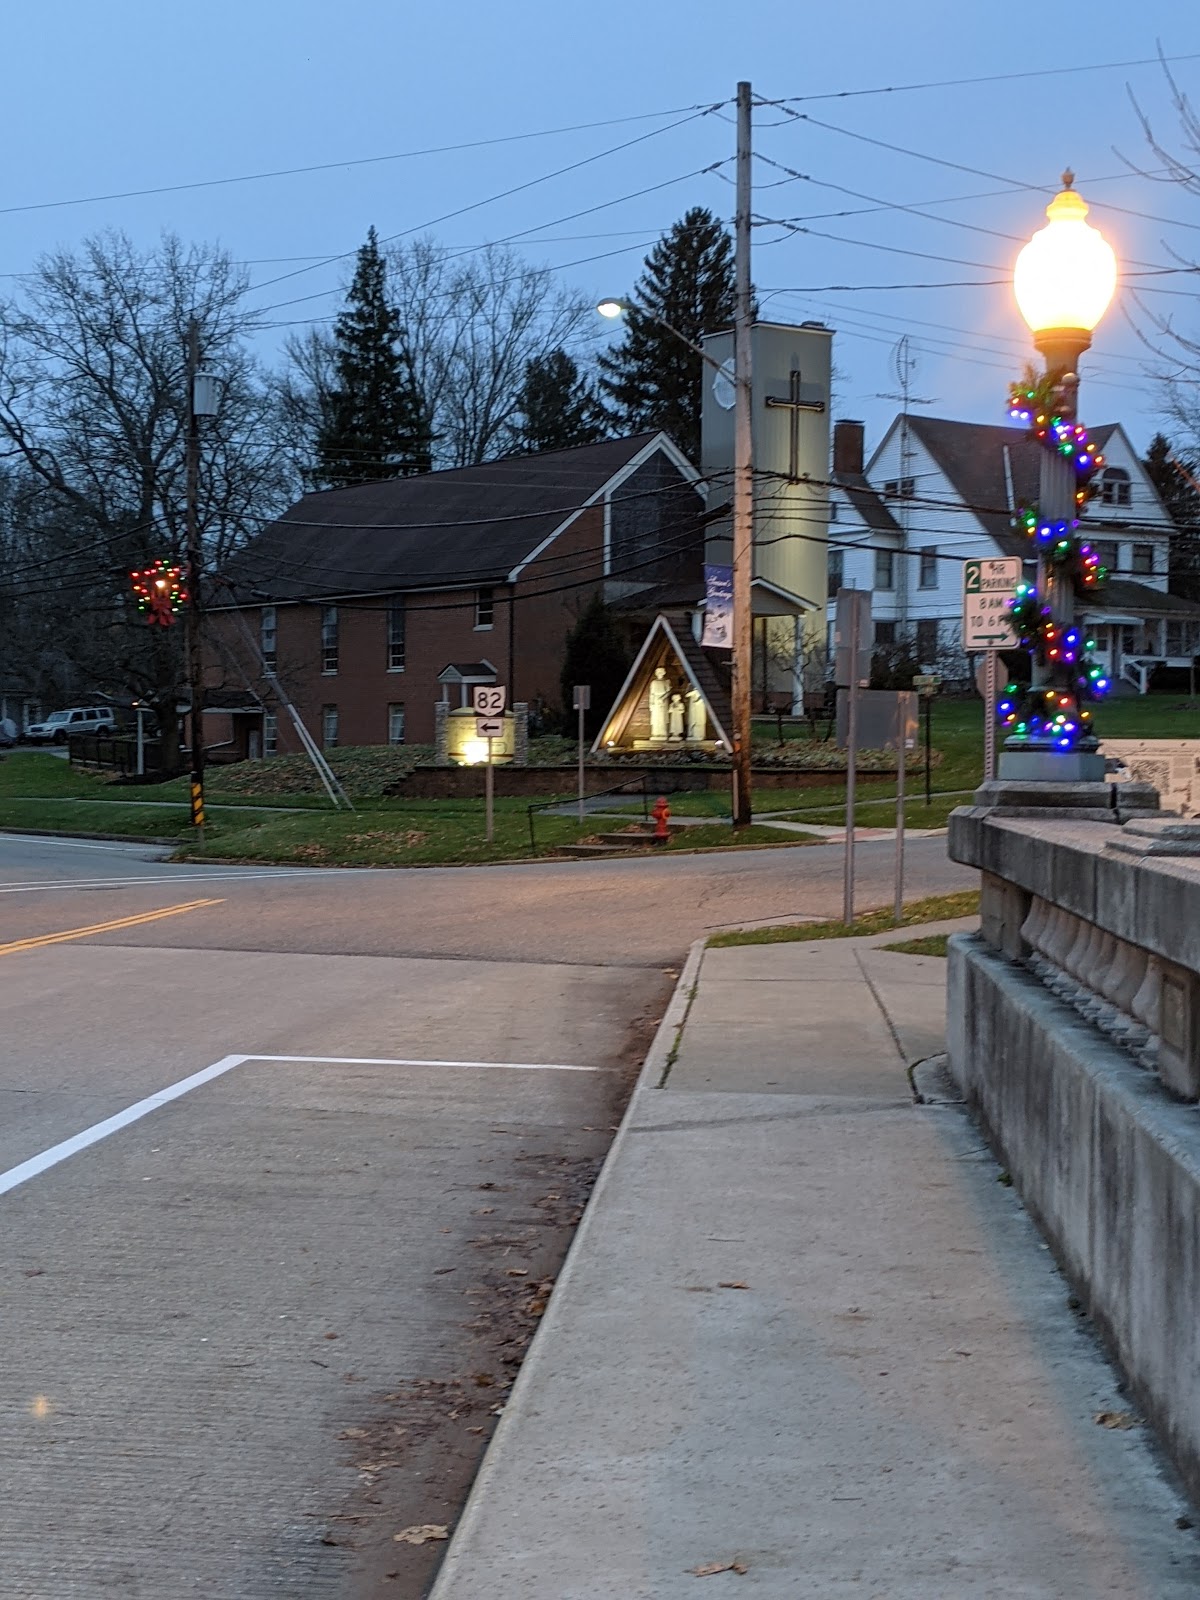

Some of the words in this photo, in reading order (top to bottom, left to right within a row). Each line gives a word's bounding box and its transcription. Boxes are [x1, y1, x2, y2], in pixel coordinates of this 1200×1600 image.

[991, 564, 1005, 574] HR
[967, 566, 980, 588] 2
[981, 577, 1016, 589] PARKING
[979, 597, 987, 609] 8
[988, 597, 1004, 609] AM
[970, 615, 984, 627] TO
[988, 615, 996, 627] 6
[478, 692, 501, 708] 82
